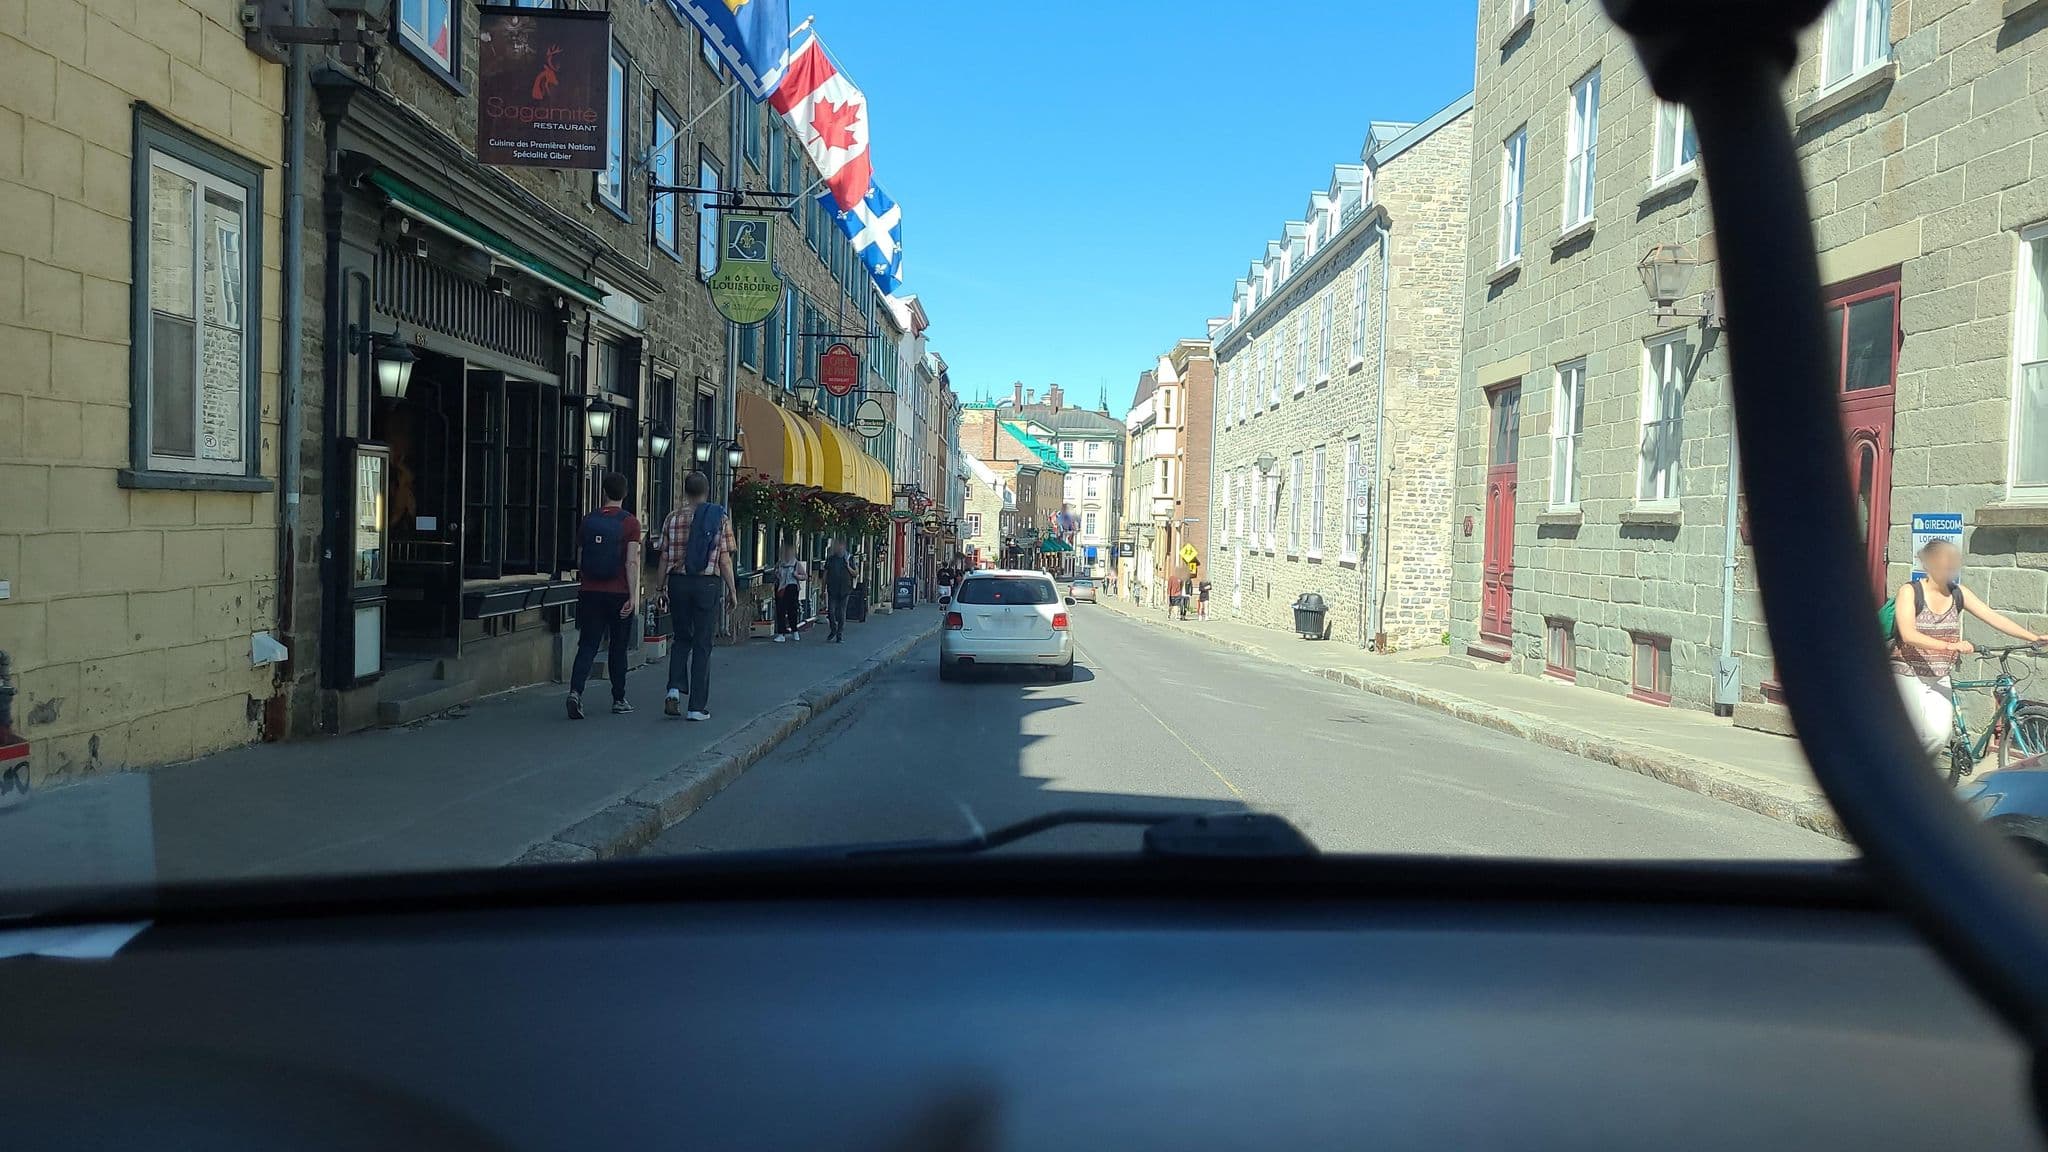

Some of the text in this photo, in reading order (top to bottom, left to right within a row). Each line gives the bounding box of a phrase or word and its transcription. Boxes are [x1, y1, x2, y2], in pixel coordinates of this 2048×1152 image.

[487, 96, 598, 123] Sagamité
[533, 122, 598, 132] RESTAURANT
[489, 139, 596, 152] Cuisine des Premières Nations
[513, 150, 572, 160] Spécialité Gibier
